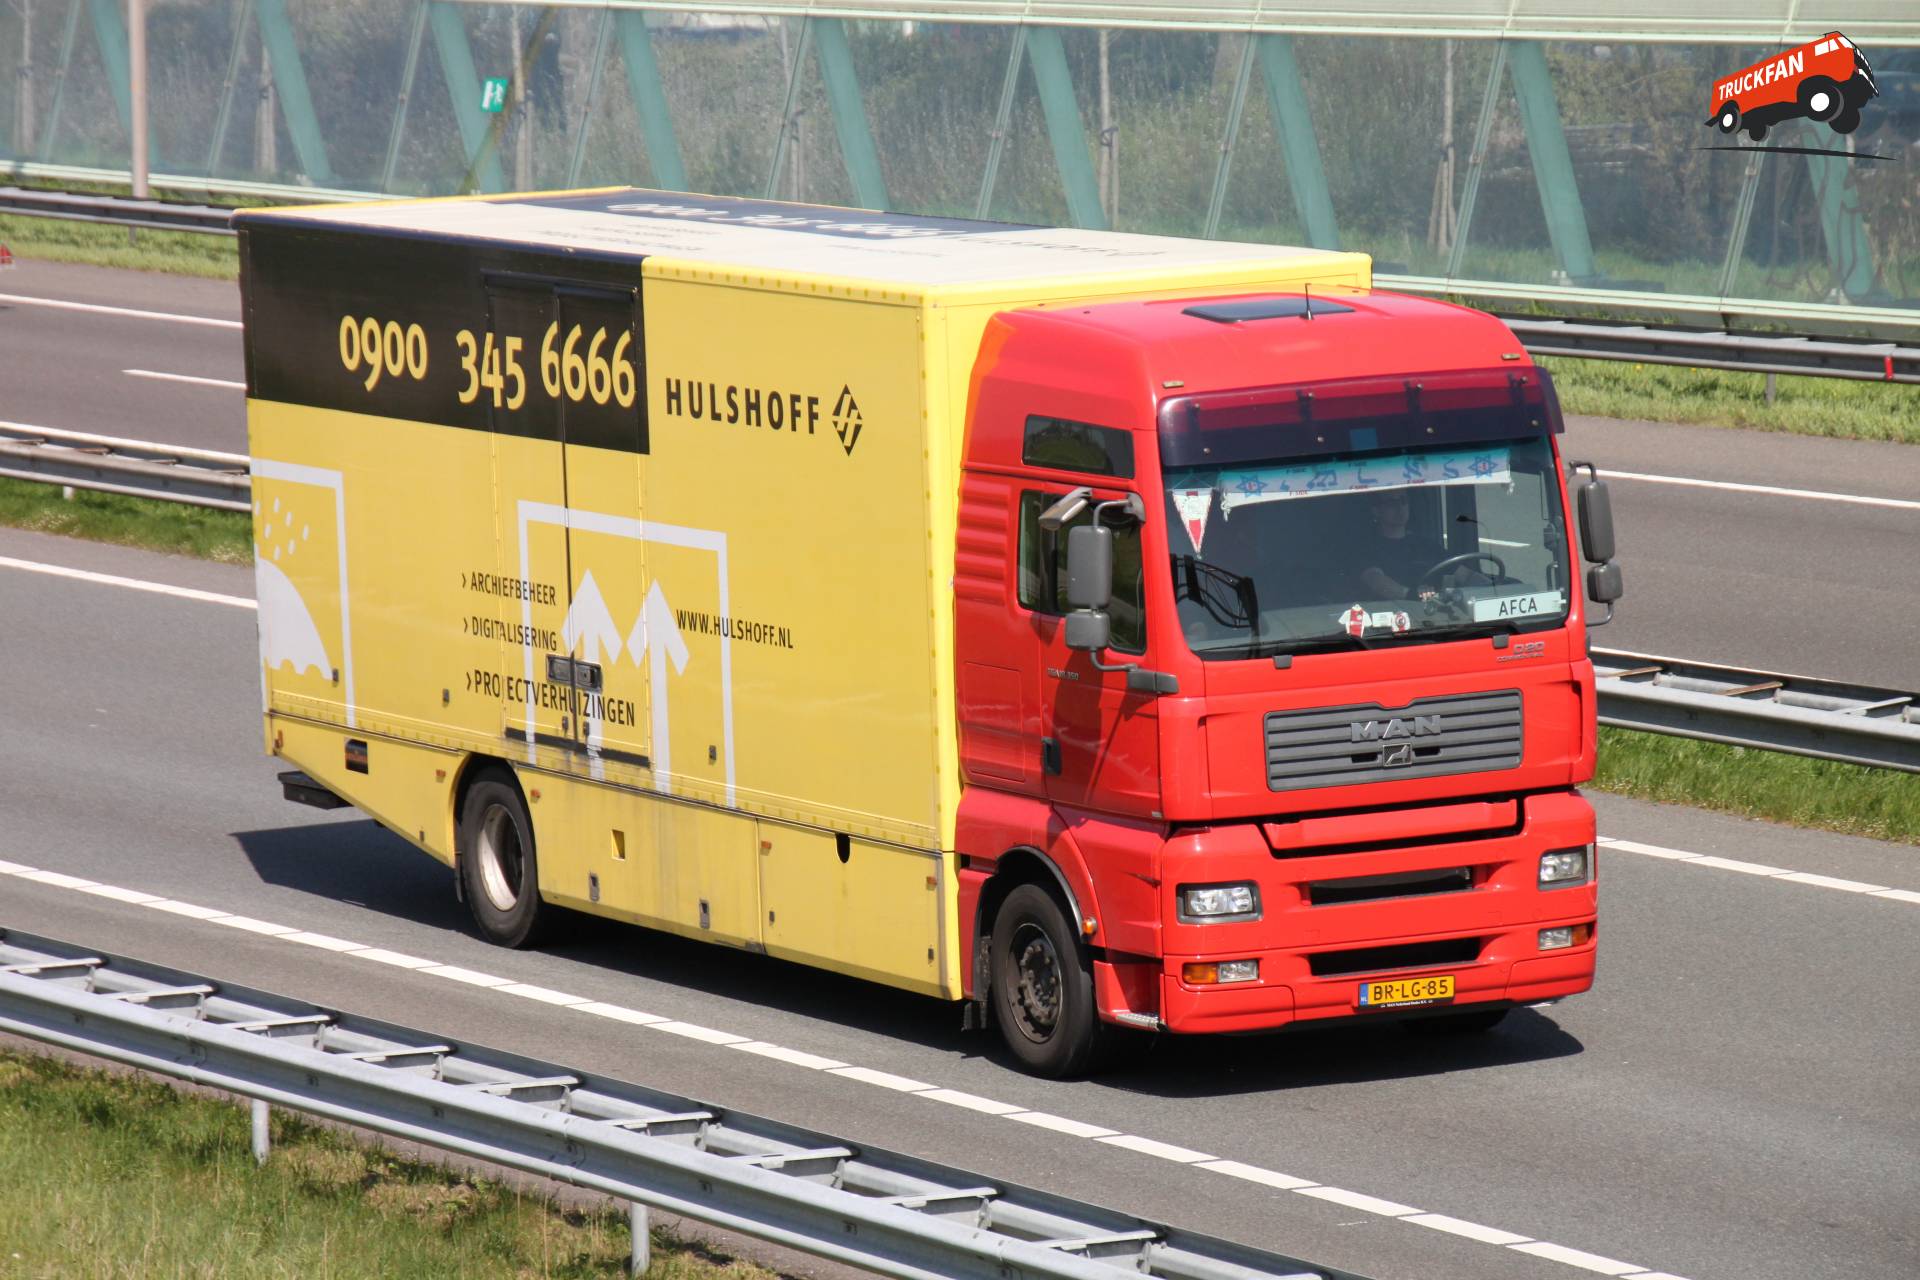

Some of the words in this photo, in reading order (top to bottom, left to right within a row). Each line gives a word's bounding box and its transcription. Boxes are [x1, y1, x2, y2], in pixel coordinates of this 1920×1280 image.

[339, 315, 428, 392] 0900
[456, 329, 526, 411] 345
[541, 320, 636, 408] 6666
[666, 377, 819, 435] HULSHOFF
[470, 571, 557, 606] ARCHIEFBEHEER
[1499, 597, 1538, 617] AFCA
[472, 616, 558, 652] DIGITALISERING
[676, 608, 794, 650] WWW.HULSHOFF.NL
[1351, 714, 1441, 742] MAN
[1373, 979, 1448, 1001] BR-LG-85
